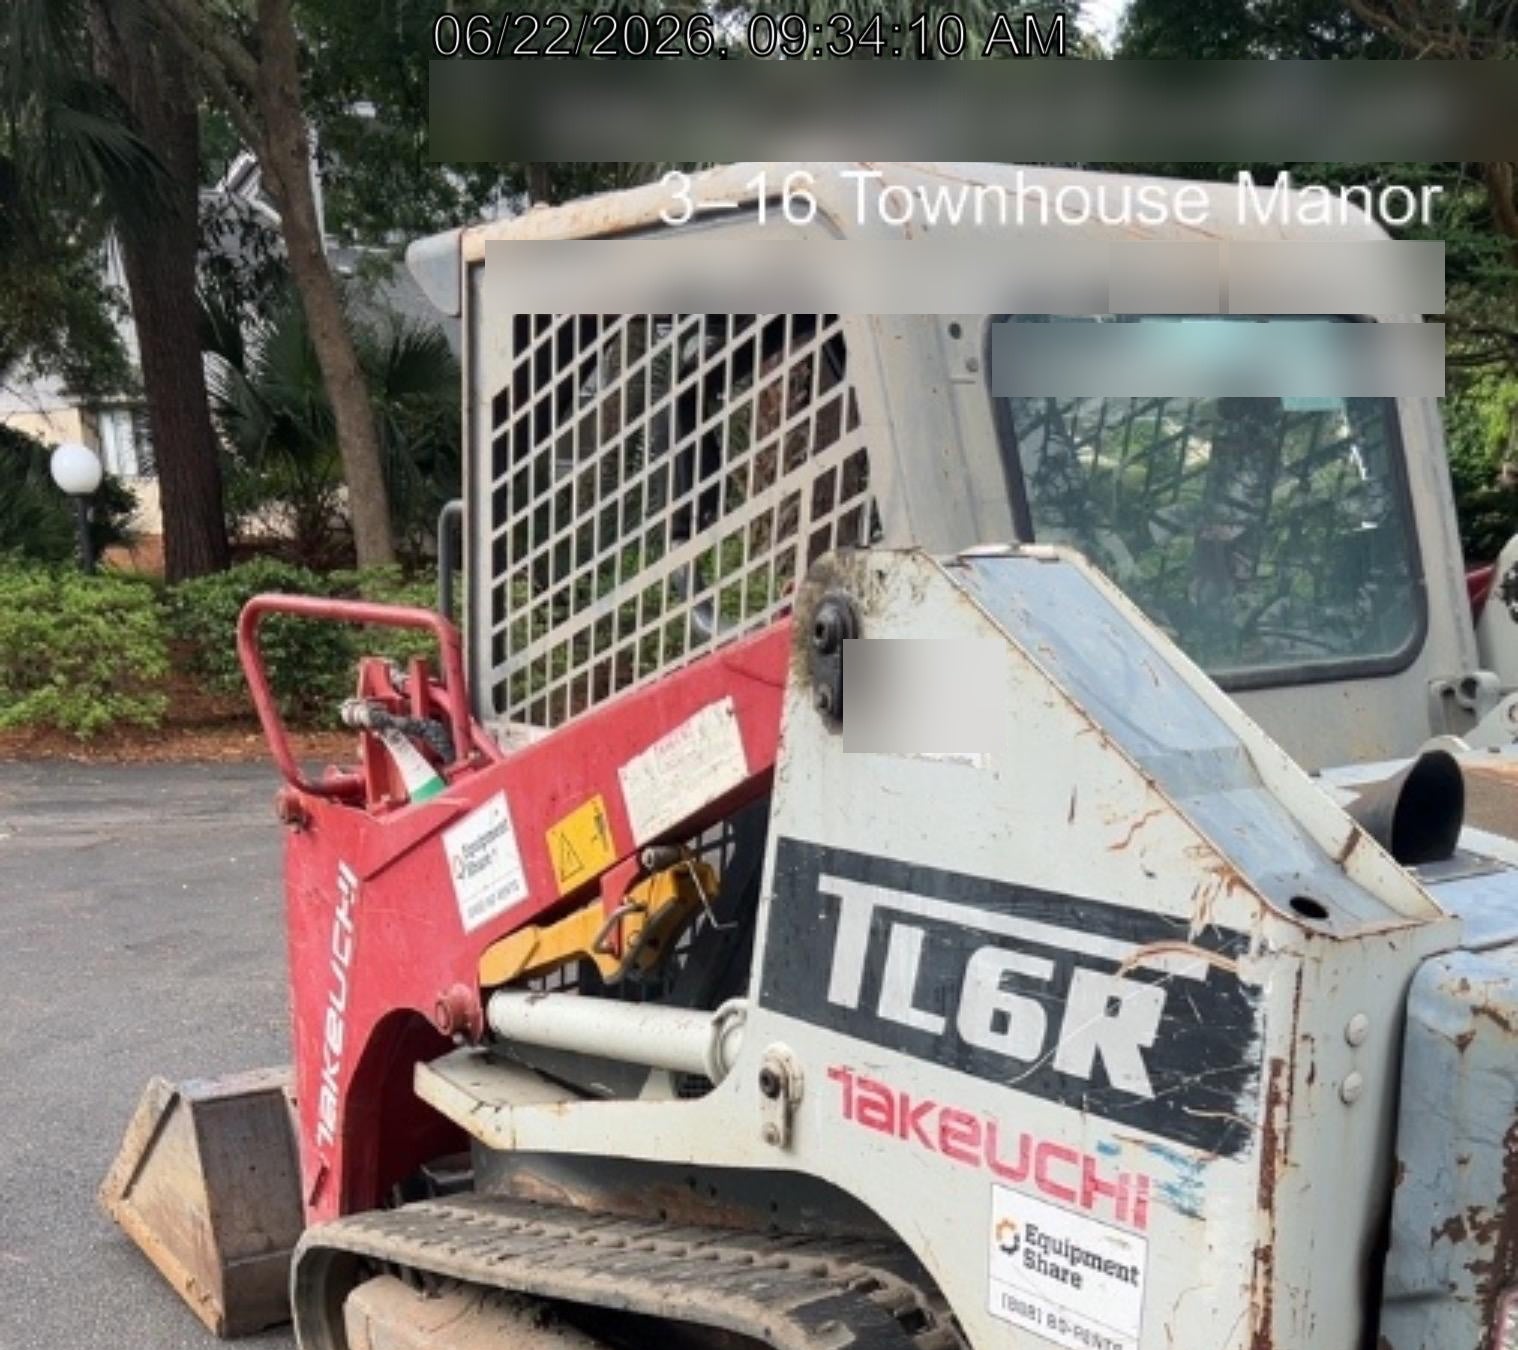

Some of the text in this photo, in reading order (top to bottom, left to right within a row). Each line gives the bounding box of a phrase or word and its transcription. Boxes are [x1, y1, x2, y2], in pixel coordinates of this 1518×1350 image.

[818, 873, 1207, 1098] TL6R
[1022, 1247, 1083, 1289] Share
[1024, 1223, 1140, 1287] Equipment
